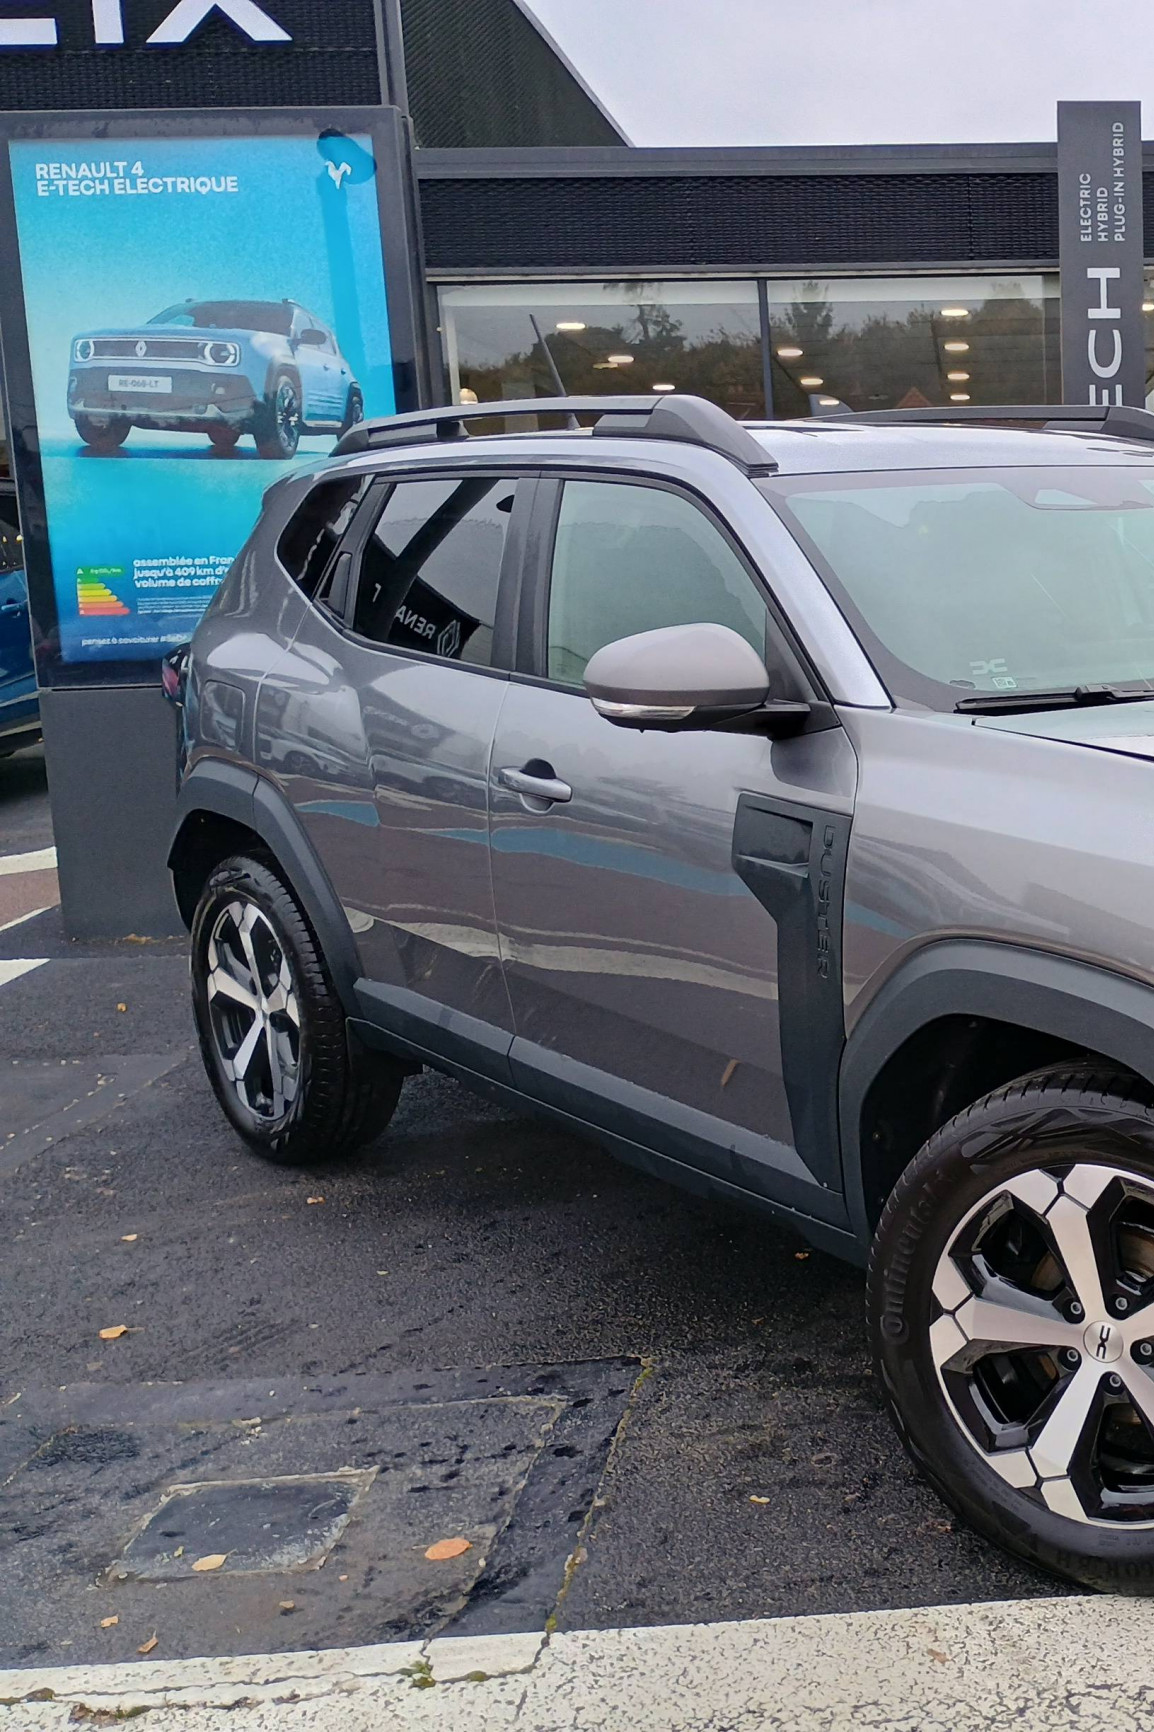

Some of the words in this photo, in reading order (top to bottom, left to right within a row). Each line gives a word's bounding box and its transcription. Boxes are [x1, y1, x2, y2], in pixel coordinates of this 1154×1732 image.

[1112, 121, 1125, 177] HYBRID
[35, 161, 127, 179] RENAULT
[131, 161, 144, 177] 4
[37, 179, 110, 197] E-TECH
[114, 176, 239, 195] ELECTRIQUE
[1079, 173, 1091, 242] ELECTRIC
[1097, 187, 1109, 242] HYBRID
[1113, 181, 1126, 242] PLUG-IN
[133, 556, 193, 567] assemblée
[194, 557, 208, 566] en
[209, 556, 235, 566] Fran
[133, 567, 173, 579] jusqu'à
[174, 567, 196, 577] 409
[196, 566, 214, 576] km
[135, 578, 176, 588] volume
[177, 577, 191, 587] de
[192, 576, 222, 587] coffr
